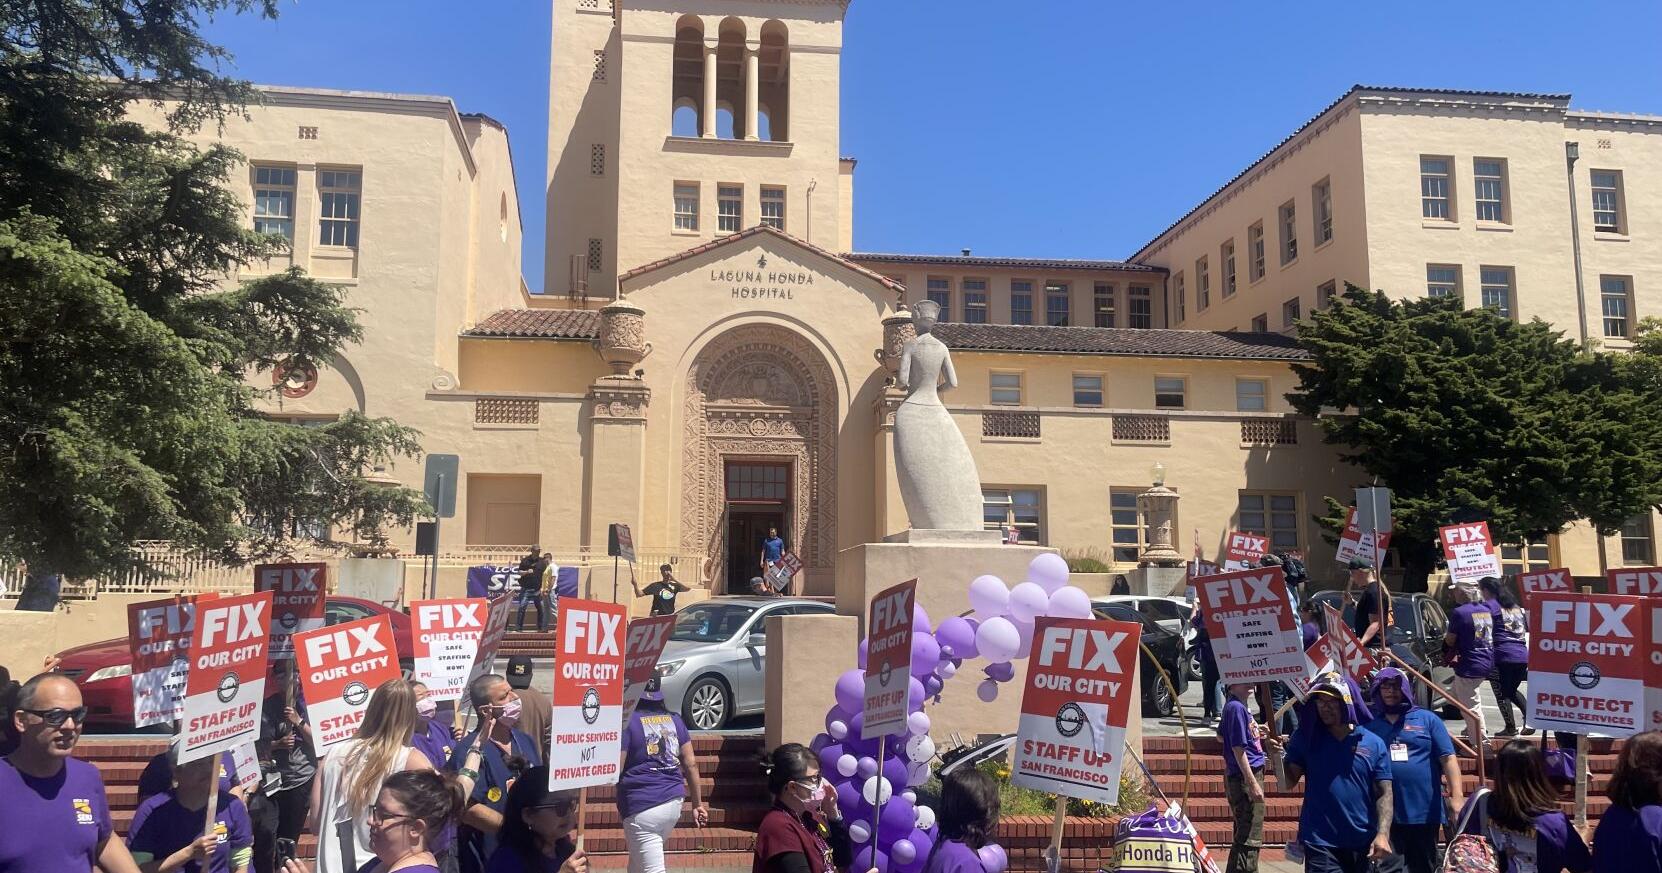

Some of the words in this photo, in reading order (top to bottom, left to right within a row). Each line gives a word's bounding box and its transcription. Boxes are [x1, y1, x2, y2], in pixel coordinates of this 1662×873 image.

[711, 270, 762, 283] LAGUNA
[768, 271, 814, 285] HONDA
[731, 287, 794, 299] HOSPITAL
[1232, 535, 1266, 552] FIX
[1445, 525, 1486, 543] FIX
[1231, 548, 1246, 556] OUR
[1247, 550, 1263, 558] CITY
[261, 568, 320, 592] FIX
[488, 574, 522, 591] SE
[1522, 572, 1568, 592] FIX
[289, 595, 319, 605] CITY
[1204, 574, 1280, 609] FIX
[418, 603, 482, 630] FIX
[872, 587, 911, 635] FIX
[1541, 600, 1635, 638] FIX
[201, 600, 267, 648] FIX
[564, 608, 622, 657] FIX
[420, 632, 450, 644] OUR
[452, 630, 483, 641] CITY
[626, 621, 671, 654] FIX
[871, 637, 887, 652] OUR
[888, 630, 907, 649] CITY
[1236, 630, 1273, 638] STAFFING
[139, 640, 175, 656] OUR
[304, 622, 387, 668] FIX
[1038, 626, 1129, 674] FIX
[1539, 639, 1581, 654] OUR
[1585, 641, 1634, 657] CITY
[197, 651, 230, 670] OUR
[232, 643, 263, 662] CITY
[635, 655, 656, 668] CITY
[1250, 658, 1269, 669] NOT
[311, 666, 348, 684] OUR
[350, 656, 388, 675] CITY
[562, 662, 592, 680] OUR
[593, 664, 619, 681] CITY
[1225, 668, 1267, 679] PRIVATE
[1269, 665, 1303, 675] GREED
[447, 676, 464, 687] NOT
[1034, 673, 1071, 692] OUR
[1075, 678, 1122, 698] CITY
[866, 694, 891, 711] STAFF
[892, 690, 904, 704] UP
[1537, 692, 1634, 714] PROTECT
[189, 707, 238, 732] STAFF
[238, 702, 257, 717] UP
[320, 709, 366, 732] STAF
[1535, 708, 1575, 719] PUBLIC
[1577, 713, 1634, 726] SERVICES
[187, 734, 207, 747] SAN
[207, 720, 255, 739] FRANCISCO
[322, 730, 344, 742] SAN
[556, 732, 585, 744] PUBLIC
[585, 731, 618, 742] SERVICES
[580, 746, 597, 763] NOT
[1023, 739, 1082, 764] STAFF
[1083, 747, 1112, 768] UP
[554, 766, 591, 780] PRIVATE
[591, 763, 617, 776] GREED
[1021, 759, 1042, 772] SAN
[1042, 763, 1109, 785] FRANCISCO
[1123, 844, 1173, 862] Honda
